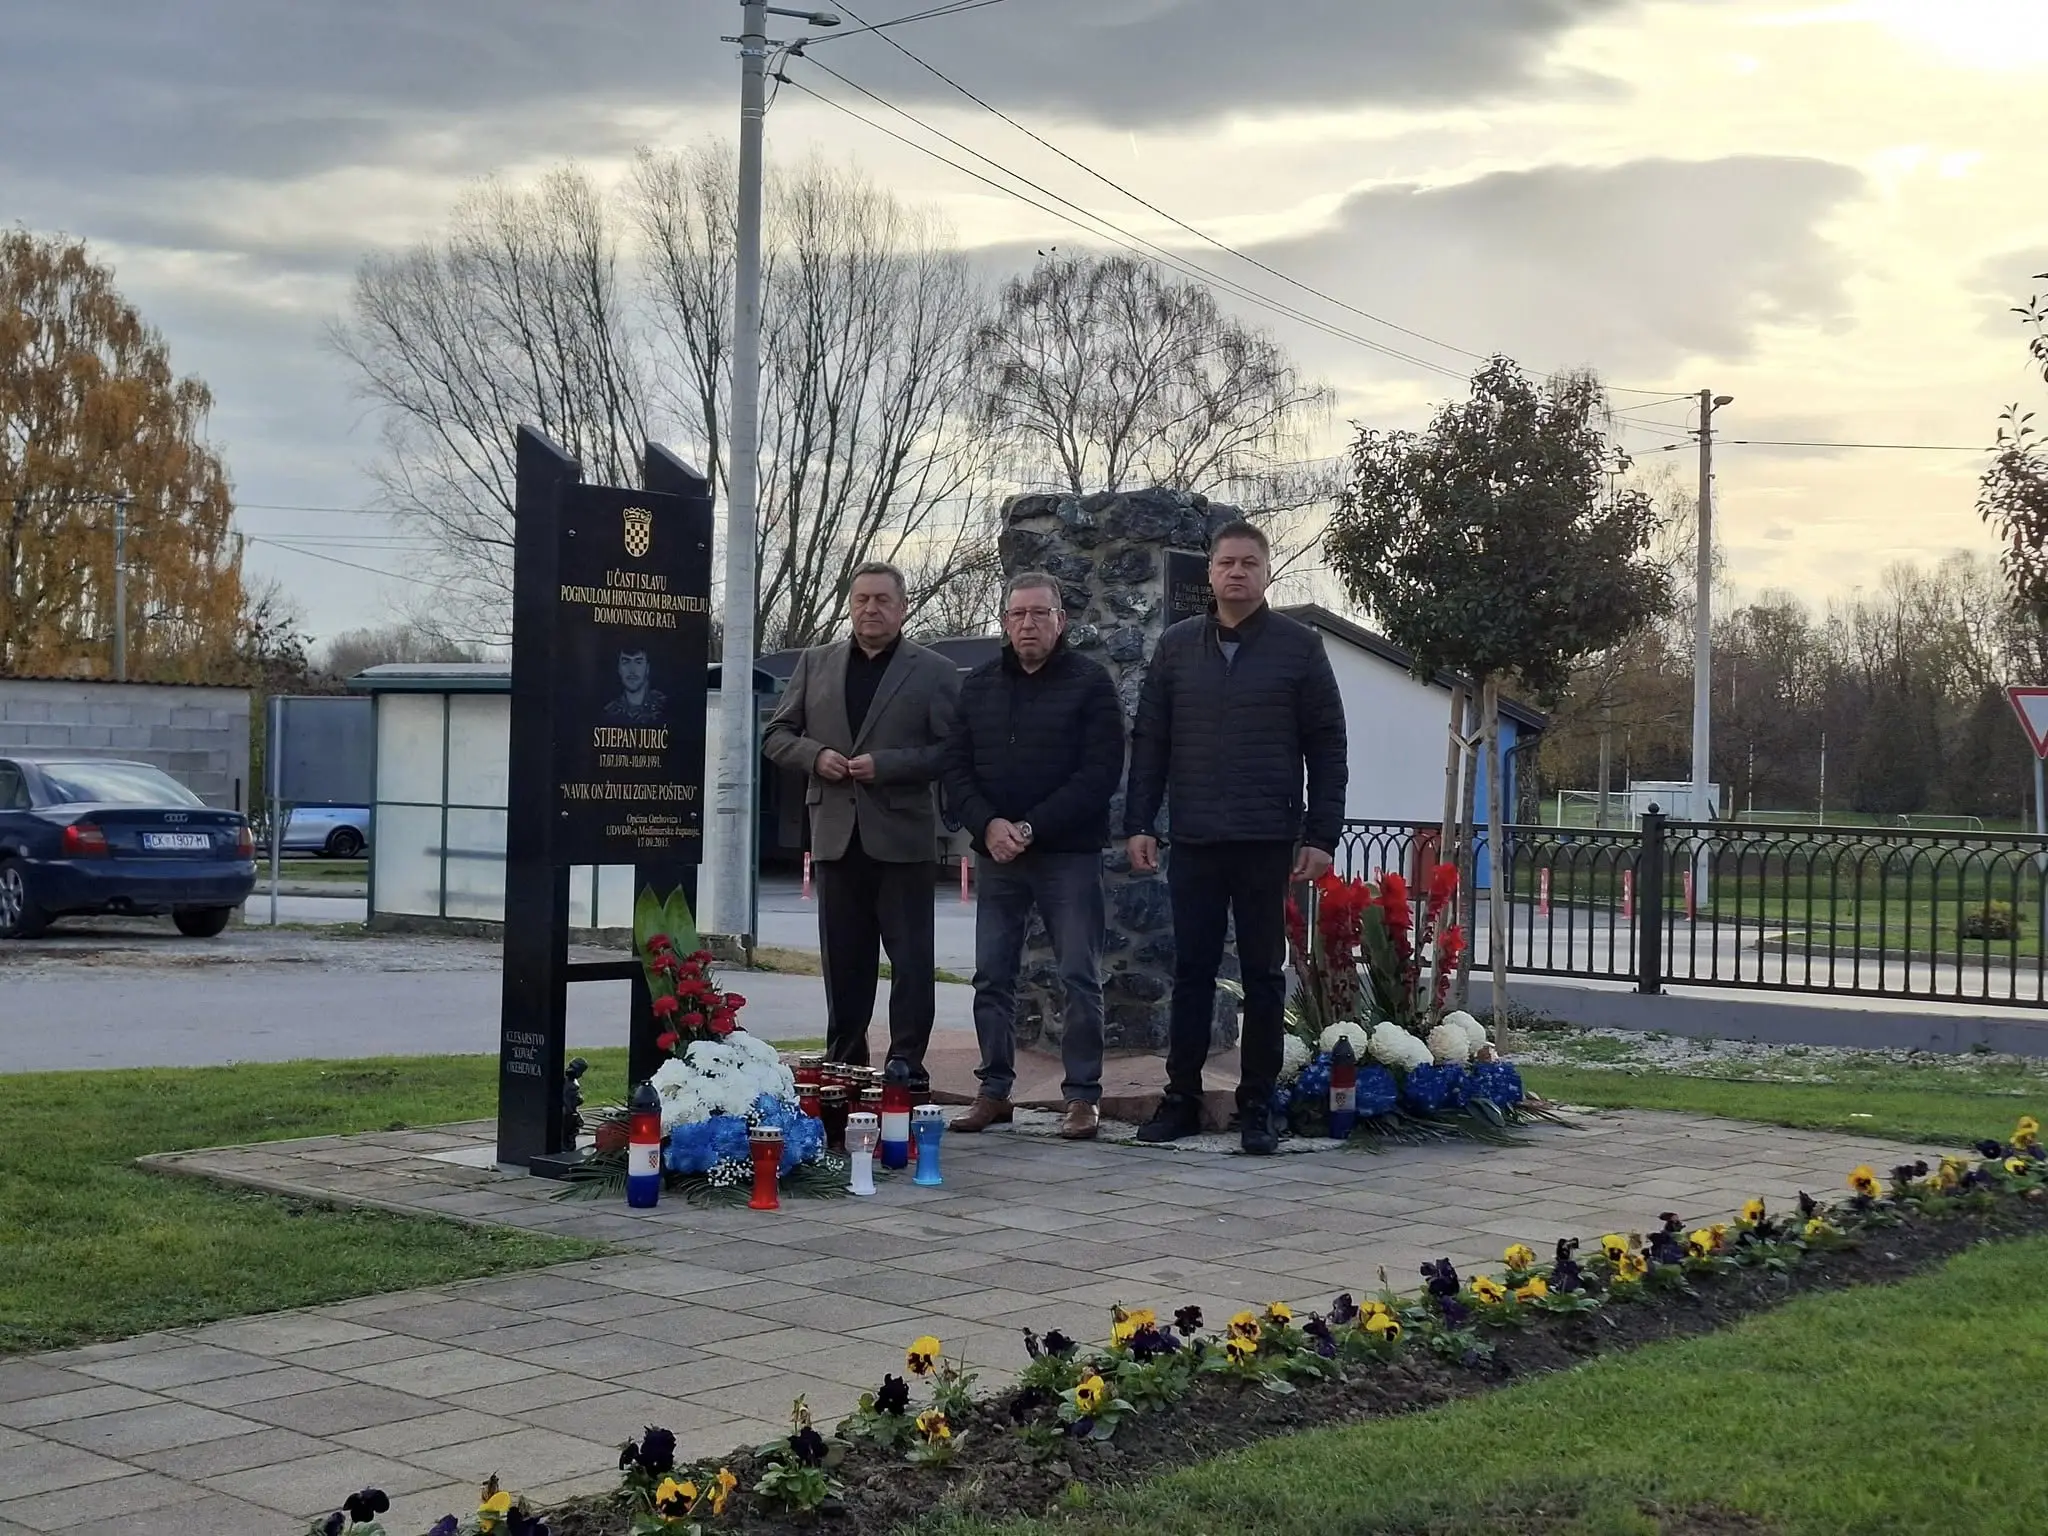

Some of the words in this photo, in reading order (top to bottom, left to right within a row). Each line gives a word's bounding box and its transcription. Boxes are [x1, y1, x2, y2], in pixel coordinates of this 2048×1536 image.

[607, 570, 613, 586] U
[614, 567, 635, 588] ČAST
[637, 574, 640, 589] I
[641, 574, 667, 591] SLAVU
[561, 585, 611, 605] POGINULOM
[612, 589, 660, 609] HRVATSKOM
[661, 593, 709, 613] BRANITELJU
[594, 606, 655, 627] DOMOVINSKOG
[656, 612, 677, 629] RATA
[593, 727, 637, 748] STJEPAN
[638, 723, 669, 749] JURIĆ
[590, 784, 604, 799] ON
[604, 780, 621, 800] ŽIVI
[622, 784, 632, 800] KI
[633, 784, 658, 800] ZGINE
[172, 835, 194, 847] 1907
